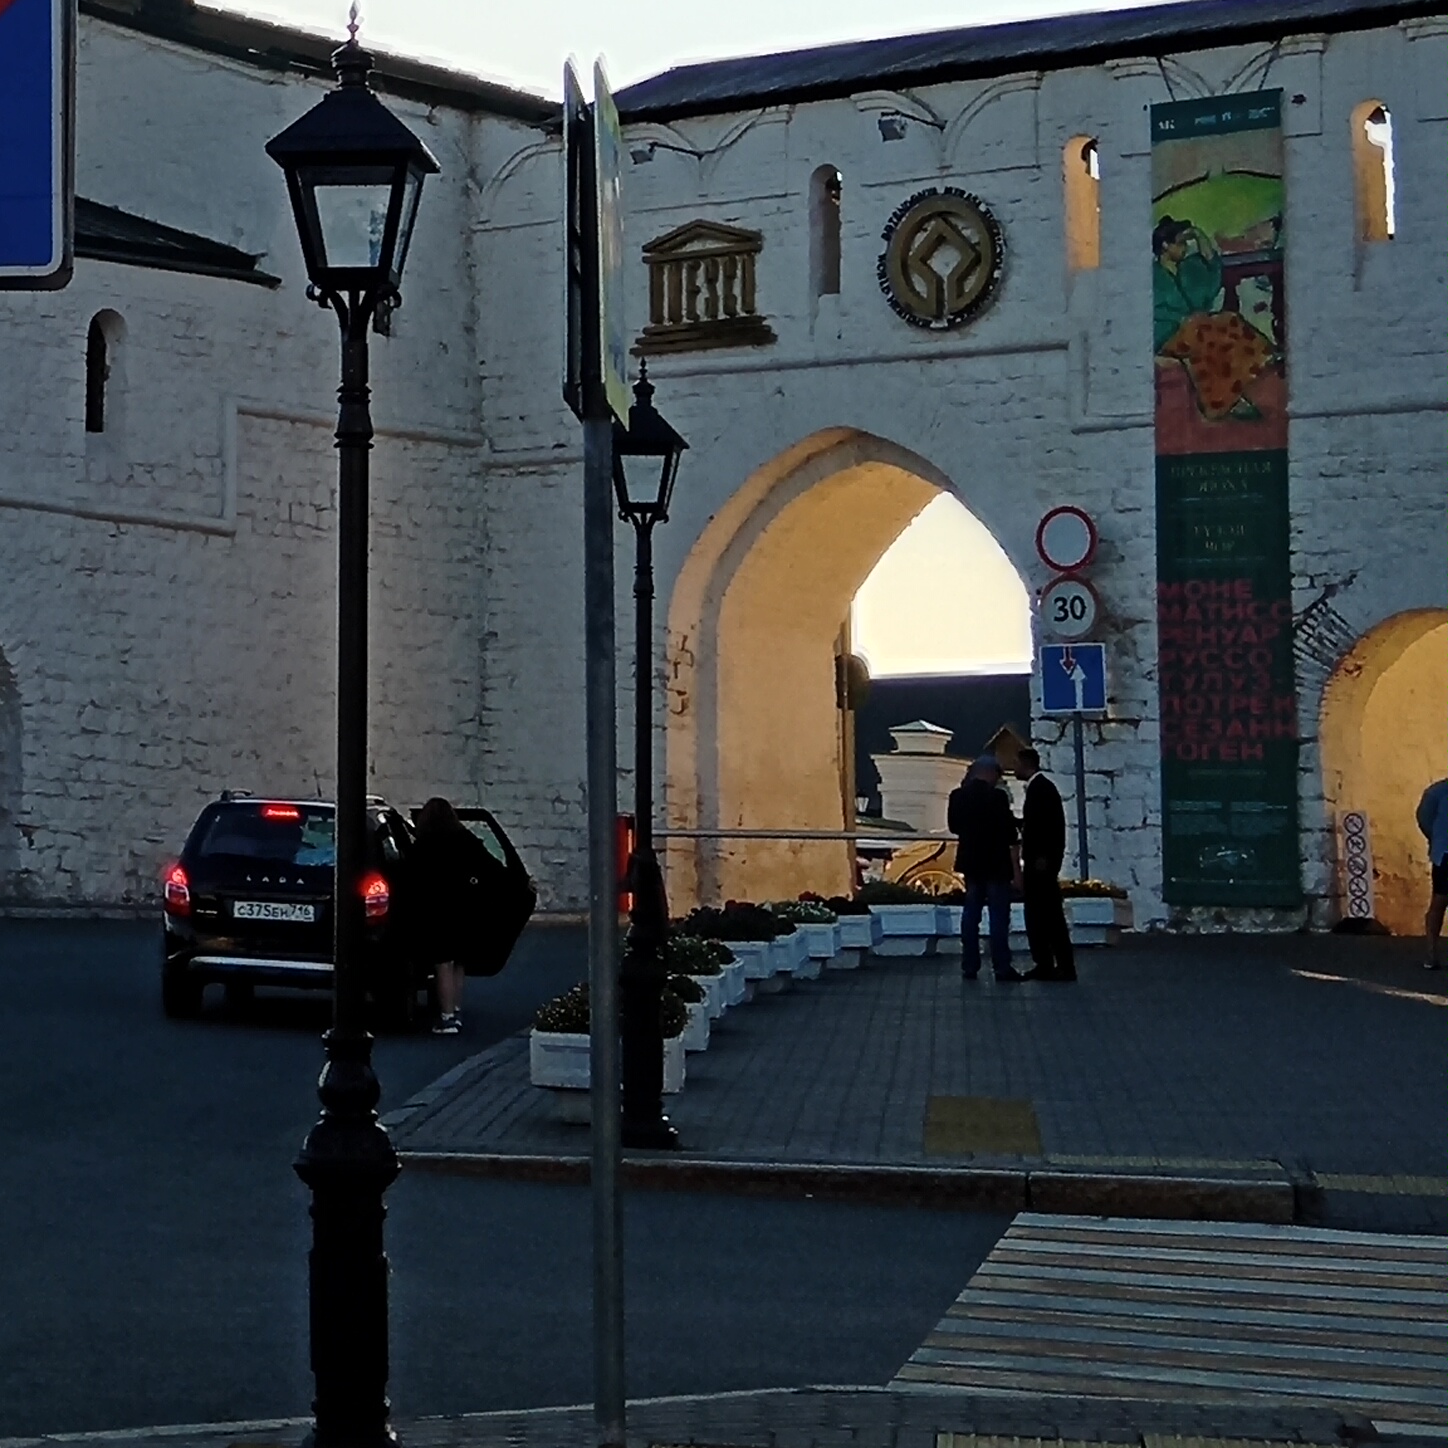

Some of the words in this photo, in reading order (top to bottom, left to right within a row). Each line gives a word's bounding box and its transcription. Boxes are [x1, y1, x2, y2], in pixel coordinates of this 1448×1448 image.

[1158, 579, 1252, 601] МОНЕ
[1054, 595, 1086, 622] 30
[1158, 599, 1293, 622] МАТИСС
[1160, 623, 1280, 645] РЕНУАР
[1160, 648, 1273, 669] РУССО
[1162, 716, 1297, 739] СЕЗАНН
[1162, 741, 1265, 762] ГОГЕН
